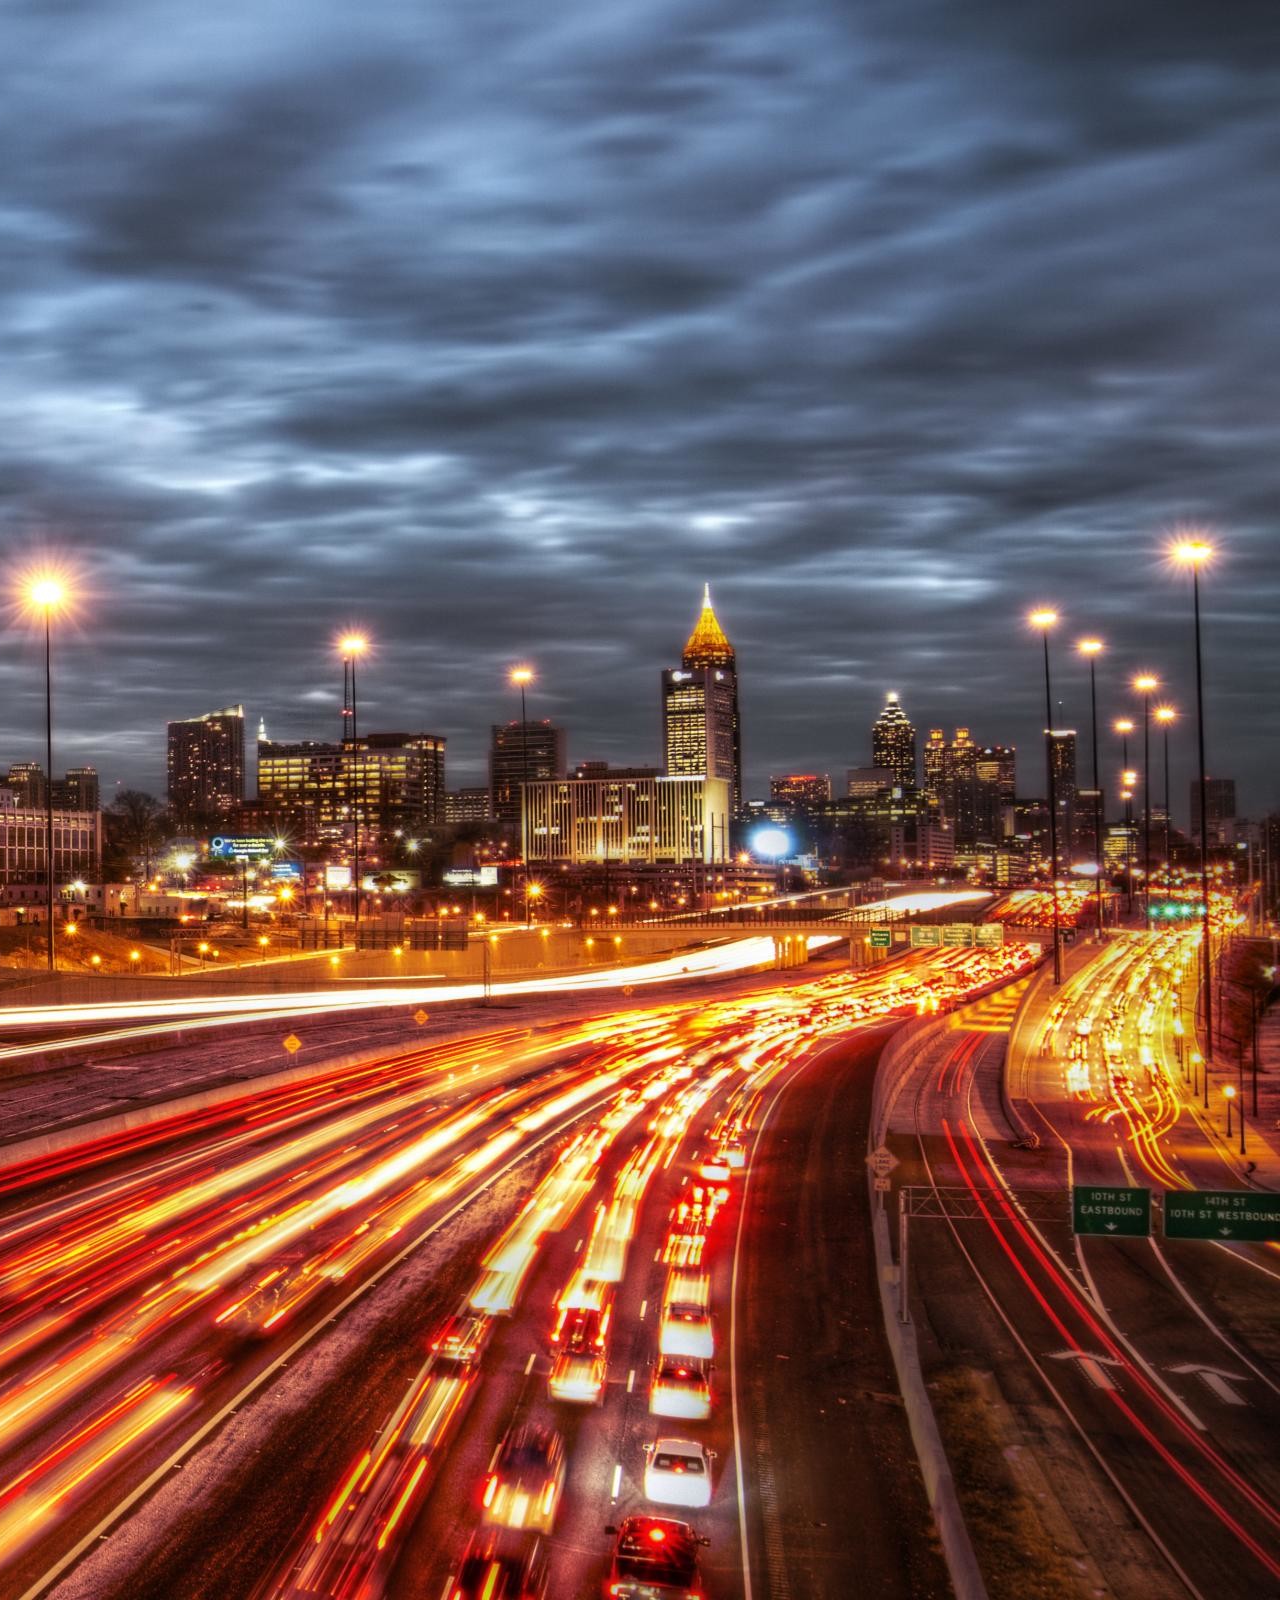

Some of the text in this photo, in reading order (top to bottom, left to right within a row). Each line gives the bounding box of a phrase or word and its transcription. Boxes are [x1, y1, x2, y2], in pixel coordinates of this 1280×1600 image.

[1091, 1192, 1132, 1202] 10TH ST
[1205, 1196, 1247, 1207] 14TH ST
[1080, 1205, 1144, 1216] EASTBOUND
[1170, 1209, 1195, 1218] 10TH
[1199, 1210, 1212, 1219] ST
